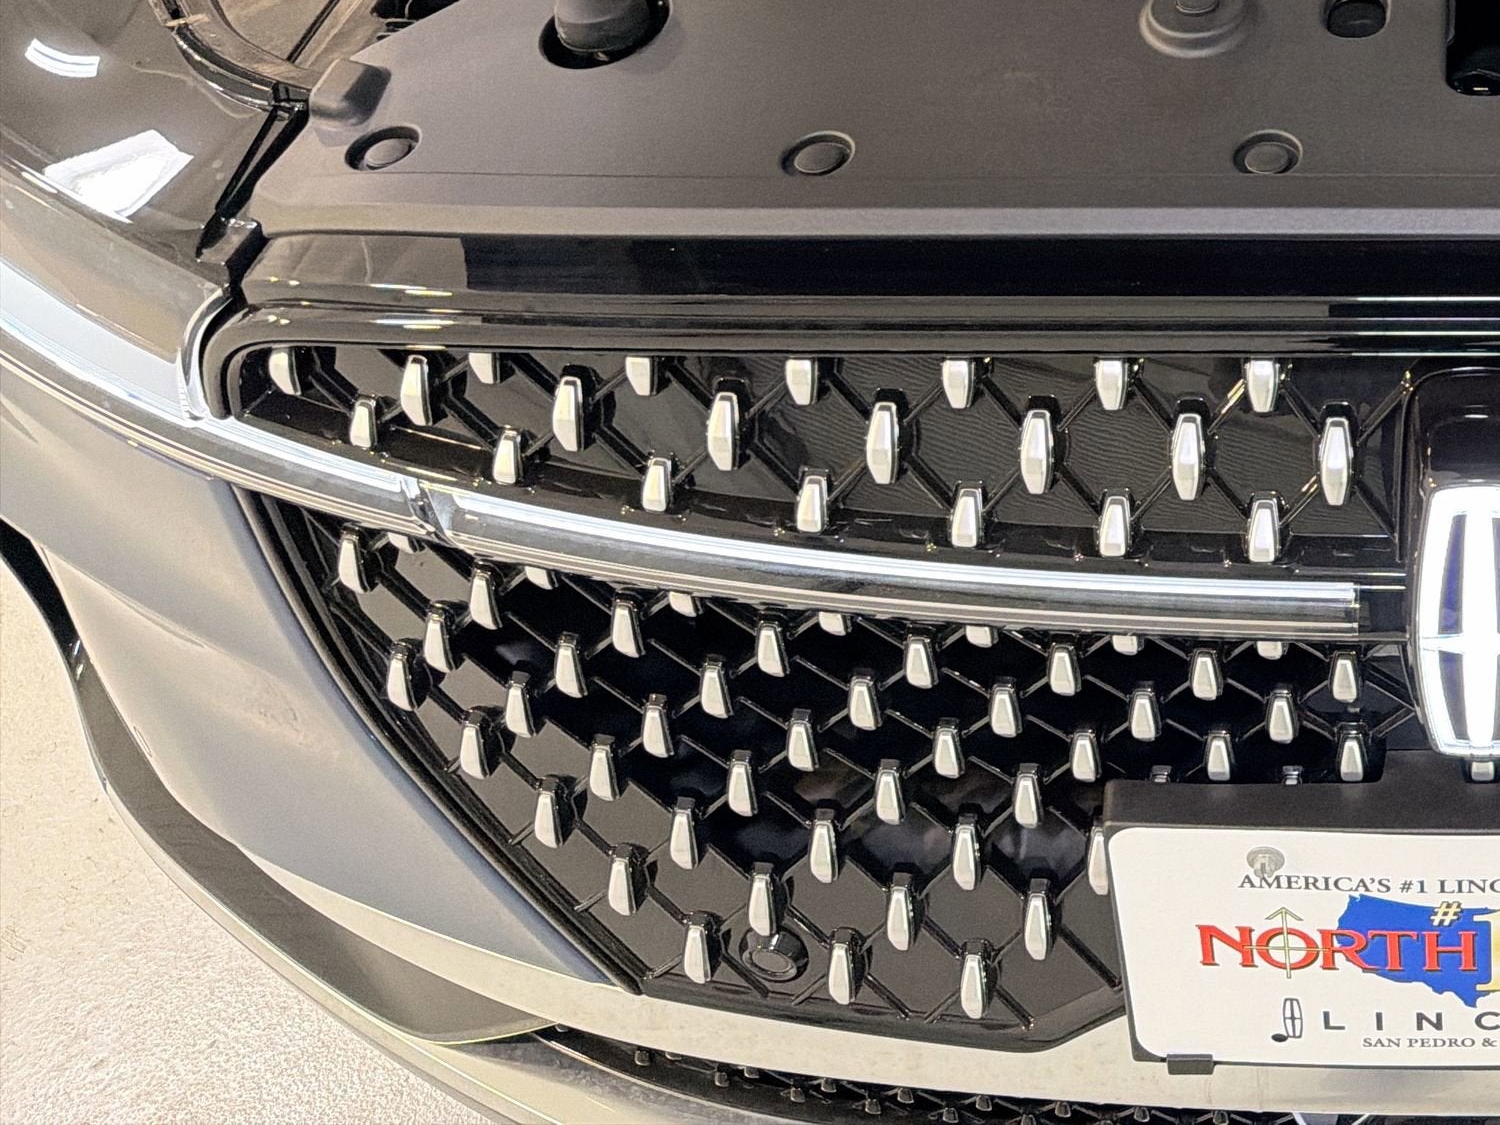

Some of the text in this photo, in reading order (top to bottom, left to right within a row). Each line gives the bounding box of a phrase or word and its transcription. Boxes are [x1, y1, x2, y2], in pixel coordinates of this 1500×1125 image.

[1238, 874, 1391, 893] AMERICA'S
[1400, 879, 1428, 894] #1
[1195, 924, 1478, 972] NORTH
[1362, 1037, 1401, 1048] SAN
[1407, 1037, 1476, 1048] PEDRO
[1481, 1037, 1498, 1047] &
